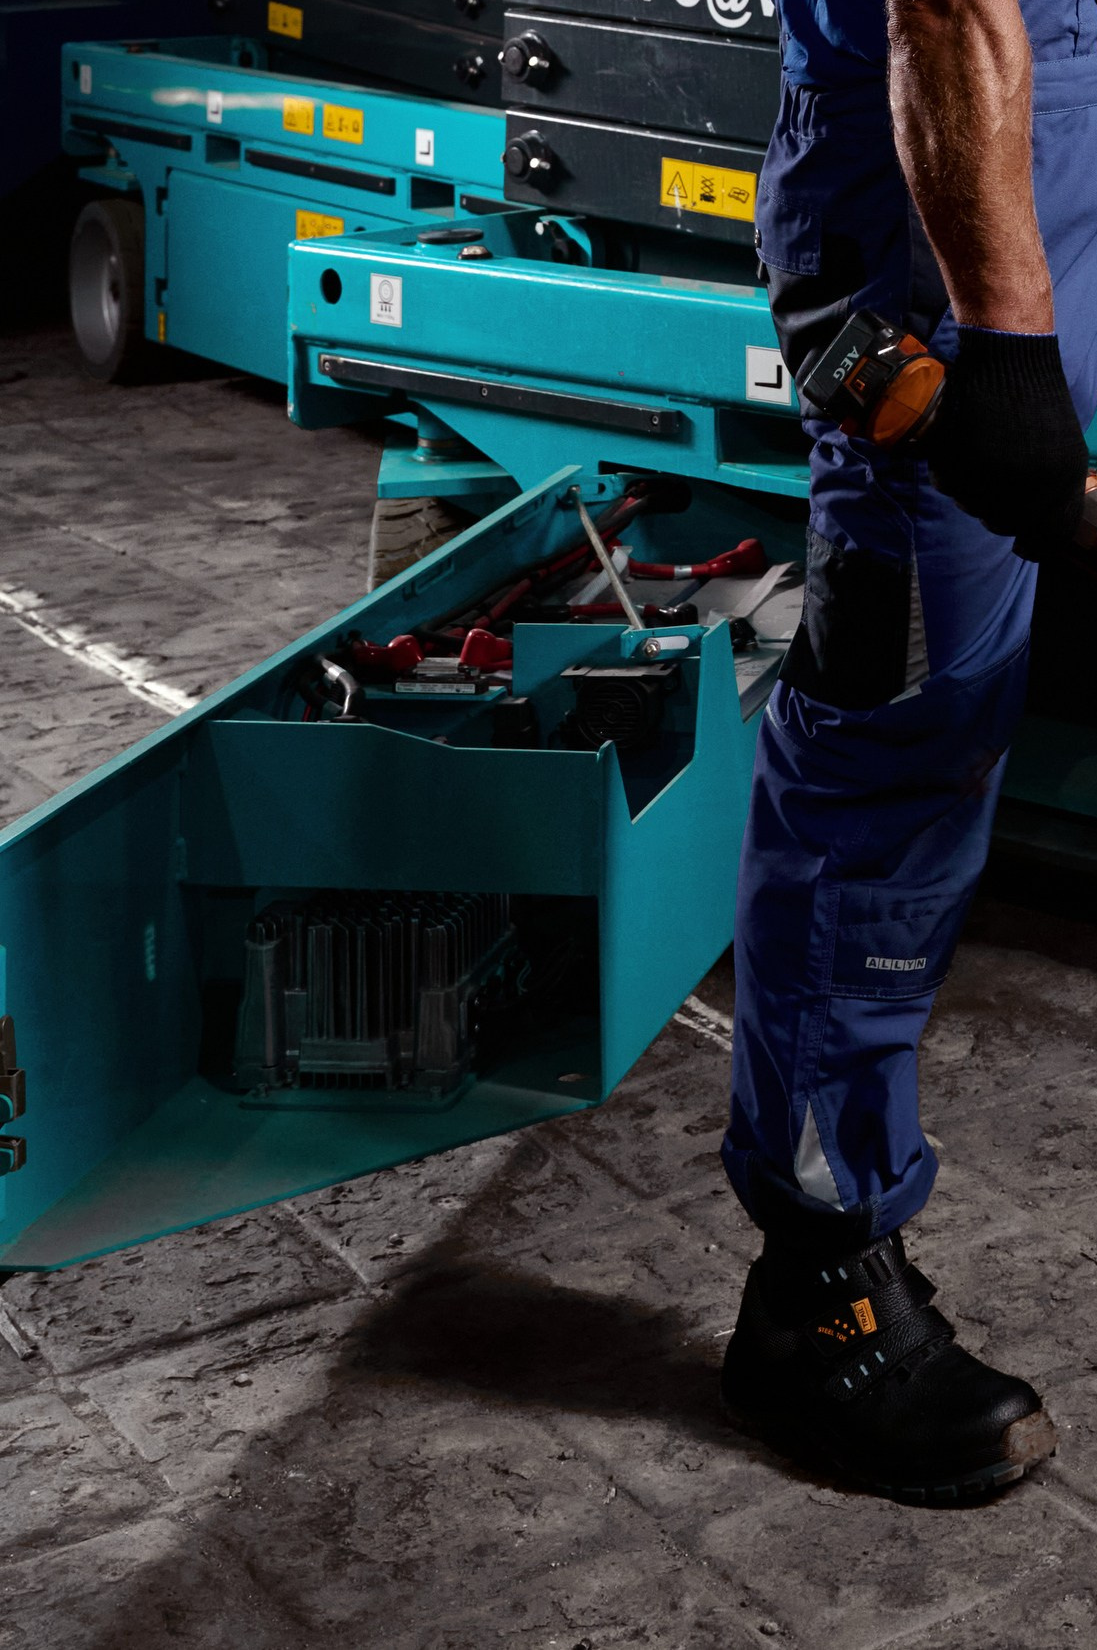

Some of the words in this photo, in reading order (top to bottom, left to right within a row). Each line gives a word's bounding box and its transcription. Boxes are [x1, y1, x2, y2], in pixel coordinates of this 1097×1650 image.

[832, 345, 860, 381] AEG
[866, 957, 926, 971] ALLYN
[817, 1326, 834, 1336] STEEL
[836, 1332, 847, 1342] TOE
